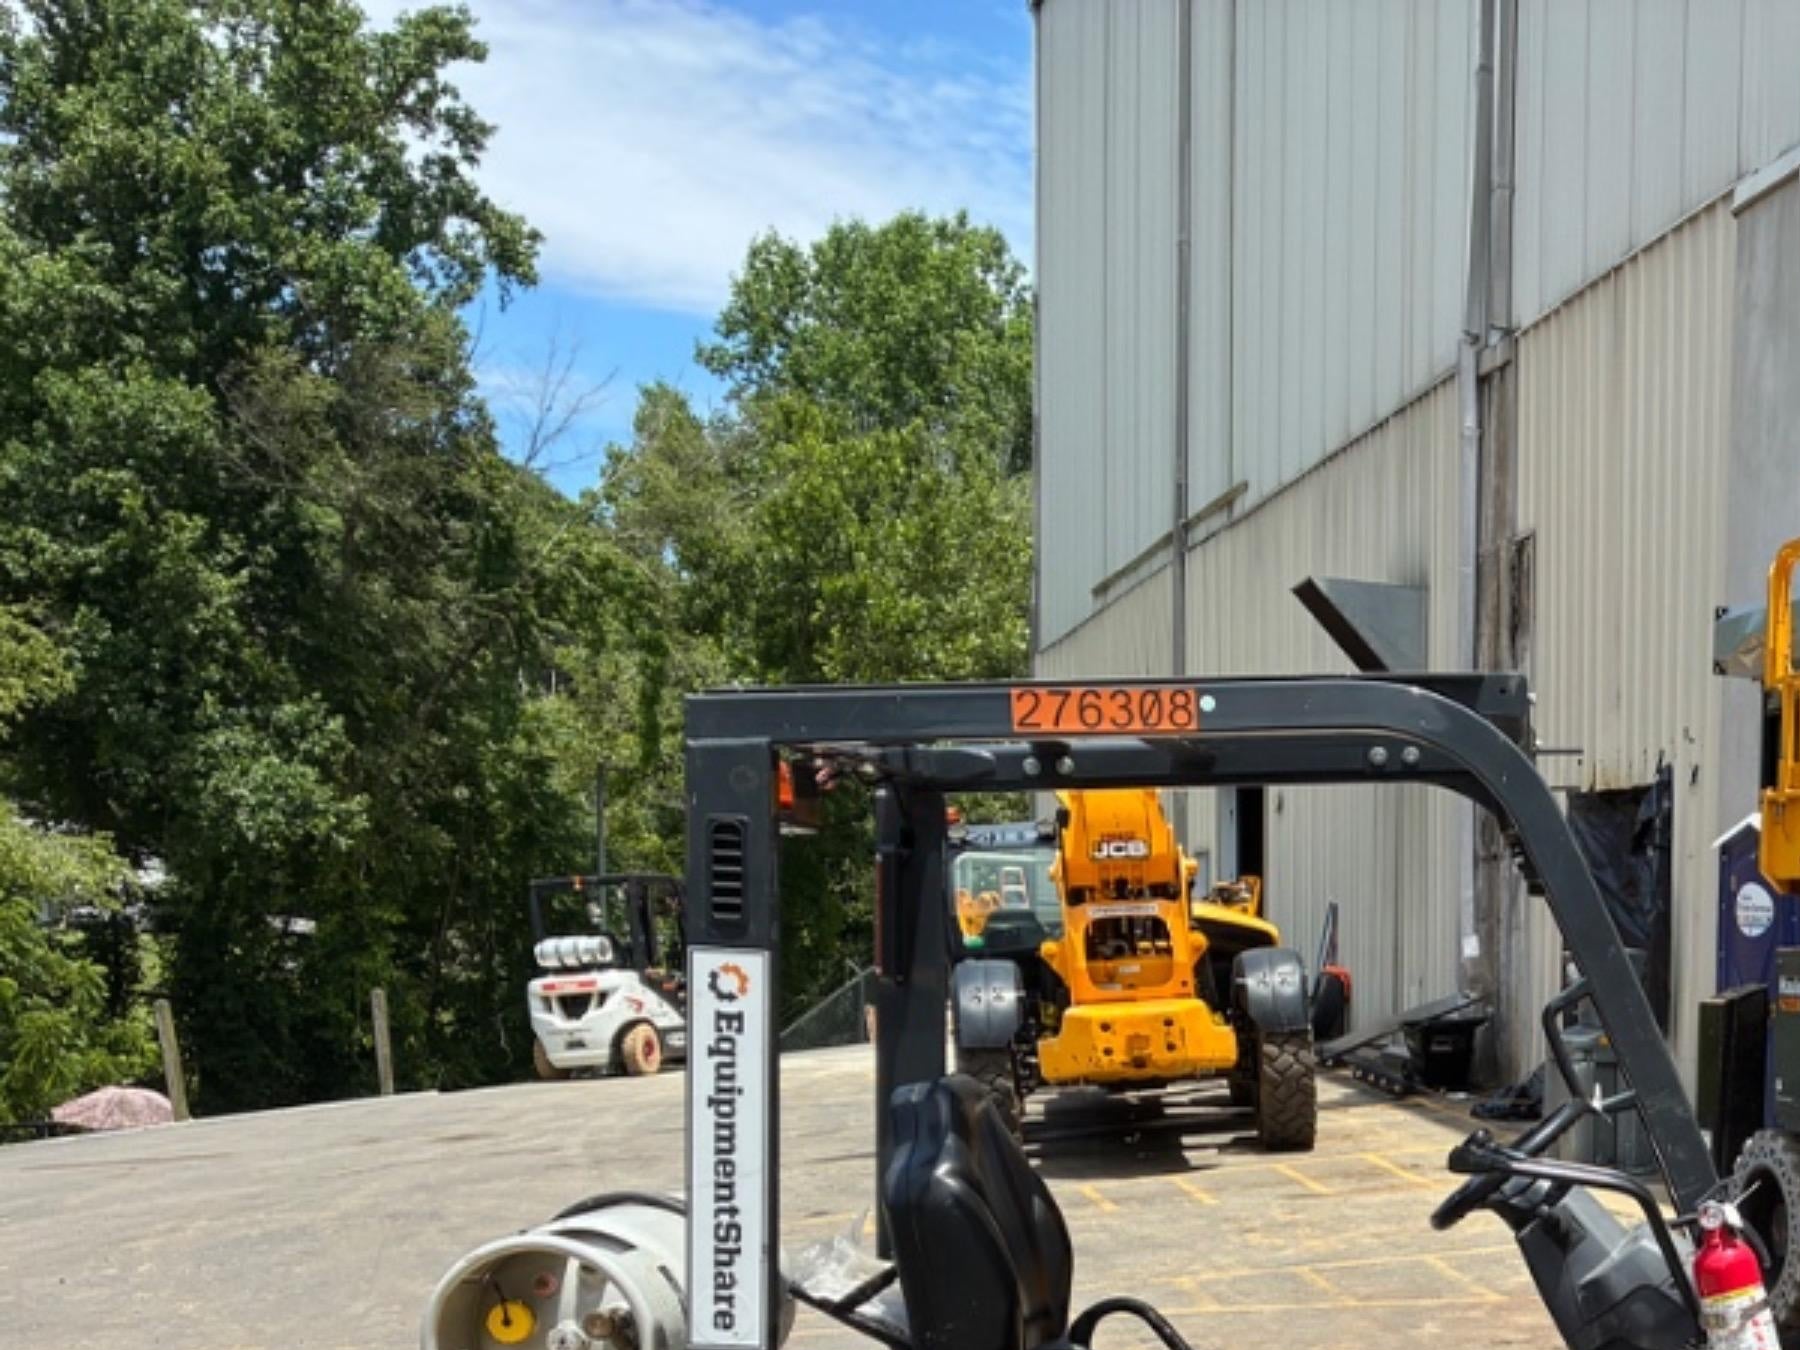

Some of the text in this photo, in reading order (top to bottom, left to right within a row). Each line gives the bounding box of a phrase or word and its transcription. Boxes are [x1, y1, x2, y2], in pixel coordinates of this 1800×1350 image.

[1014, 688, 1195, 731] 276308
[1094, 840, 1148, 858] JCB
[707, 1012, 744, 1331] EquipmentShare
